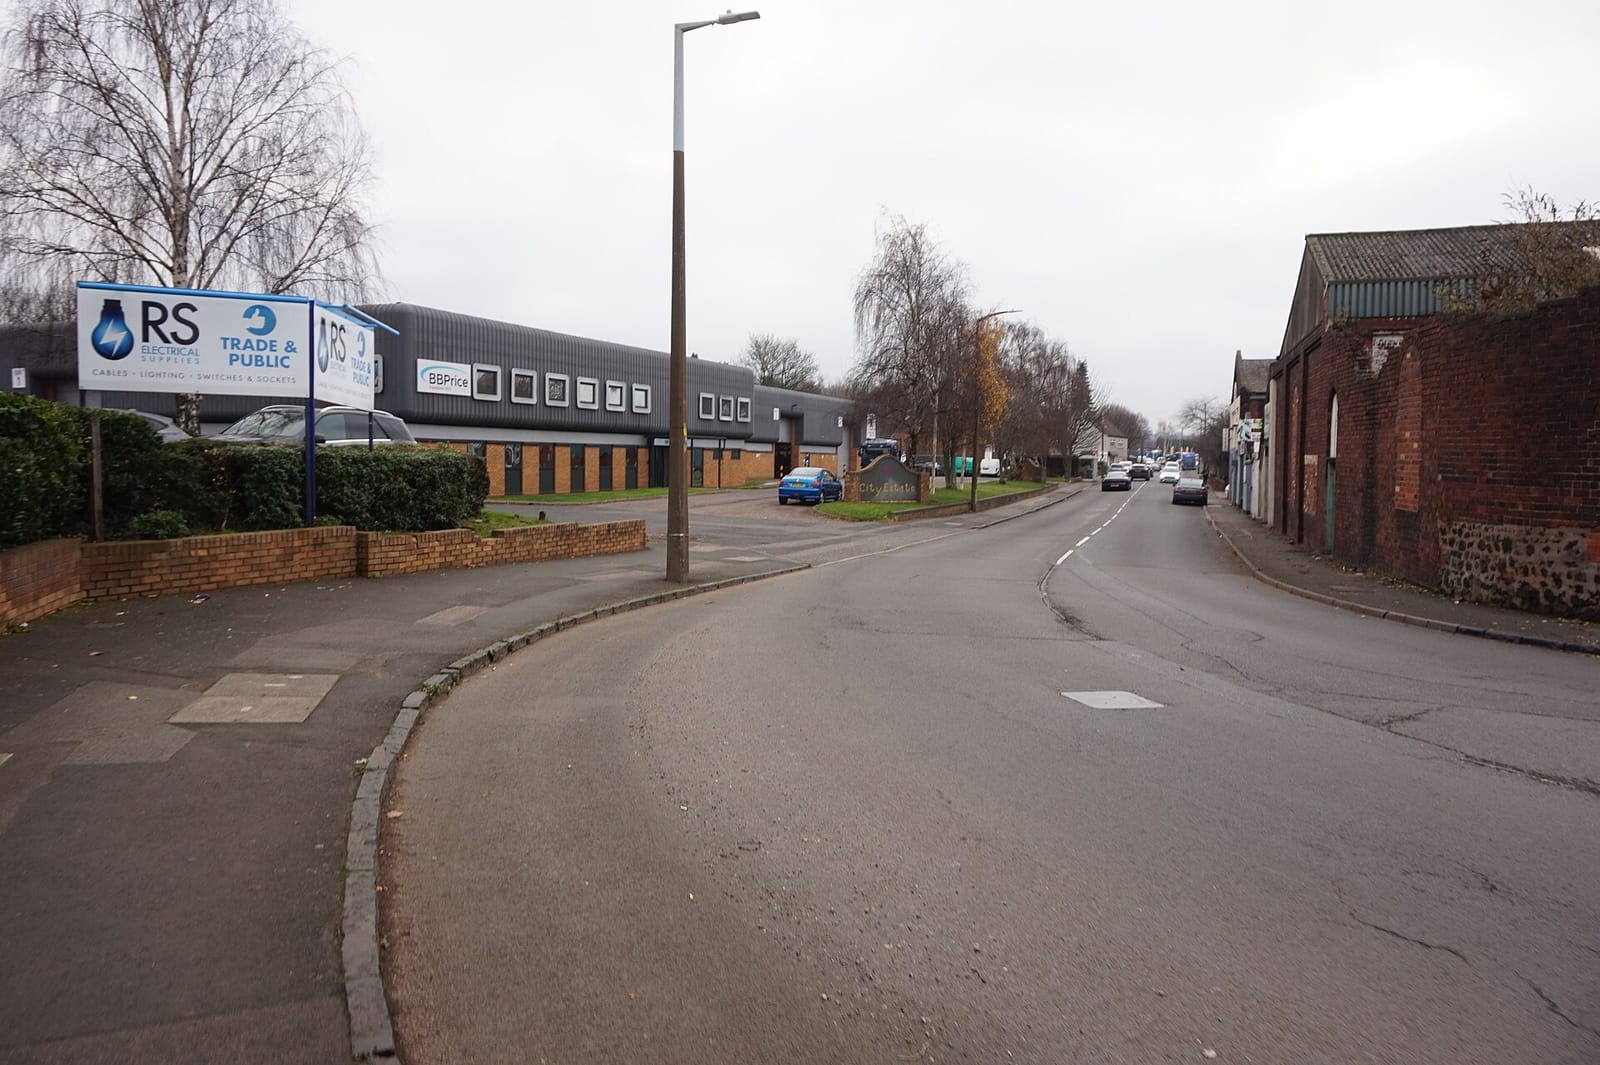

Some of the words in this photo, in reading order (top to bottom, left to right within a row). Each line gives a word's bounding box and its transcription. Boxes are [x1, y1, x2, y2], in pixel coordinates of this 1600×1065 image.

[141, 300, 200, 346] RS
[220, 336, 277, 352] TRADE
[284, 340, 298, 353] &
[330, 321, 347, 363] RS
[141, 345, 201, 357] ELECTRICAL
[141, 356, 200, 365] SUPPLIES
[228, 353, 291, 368] PUBLIC
[92, 368, 128, 377] CABLES
[140, 371, 185, 380] LIGHTING
[197, 373, 243, 382] SWITCHES
[257, 376, 297, 384] SOCKETS
[429, 372, 468, 388] BBPrice
